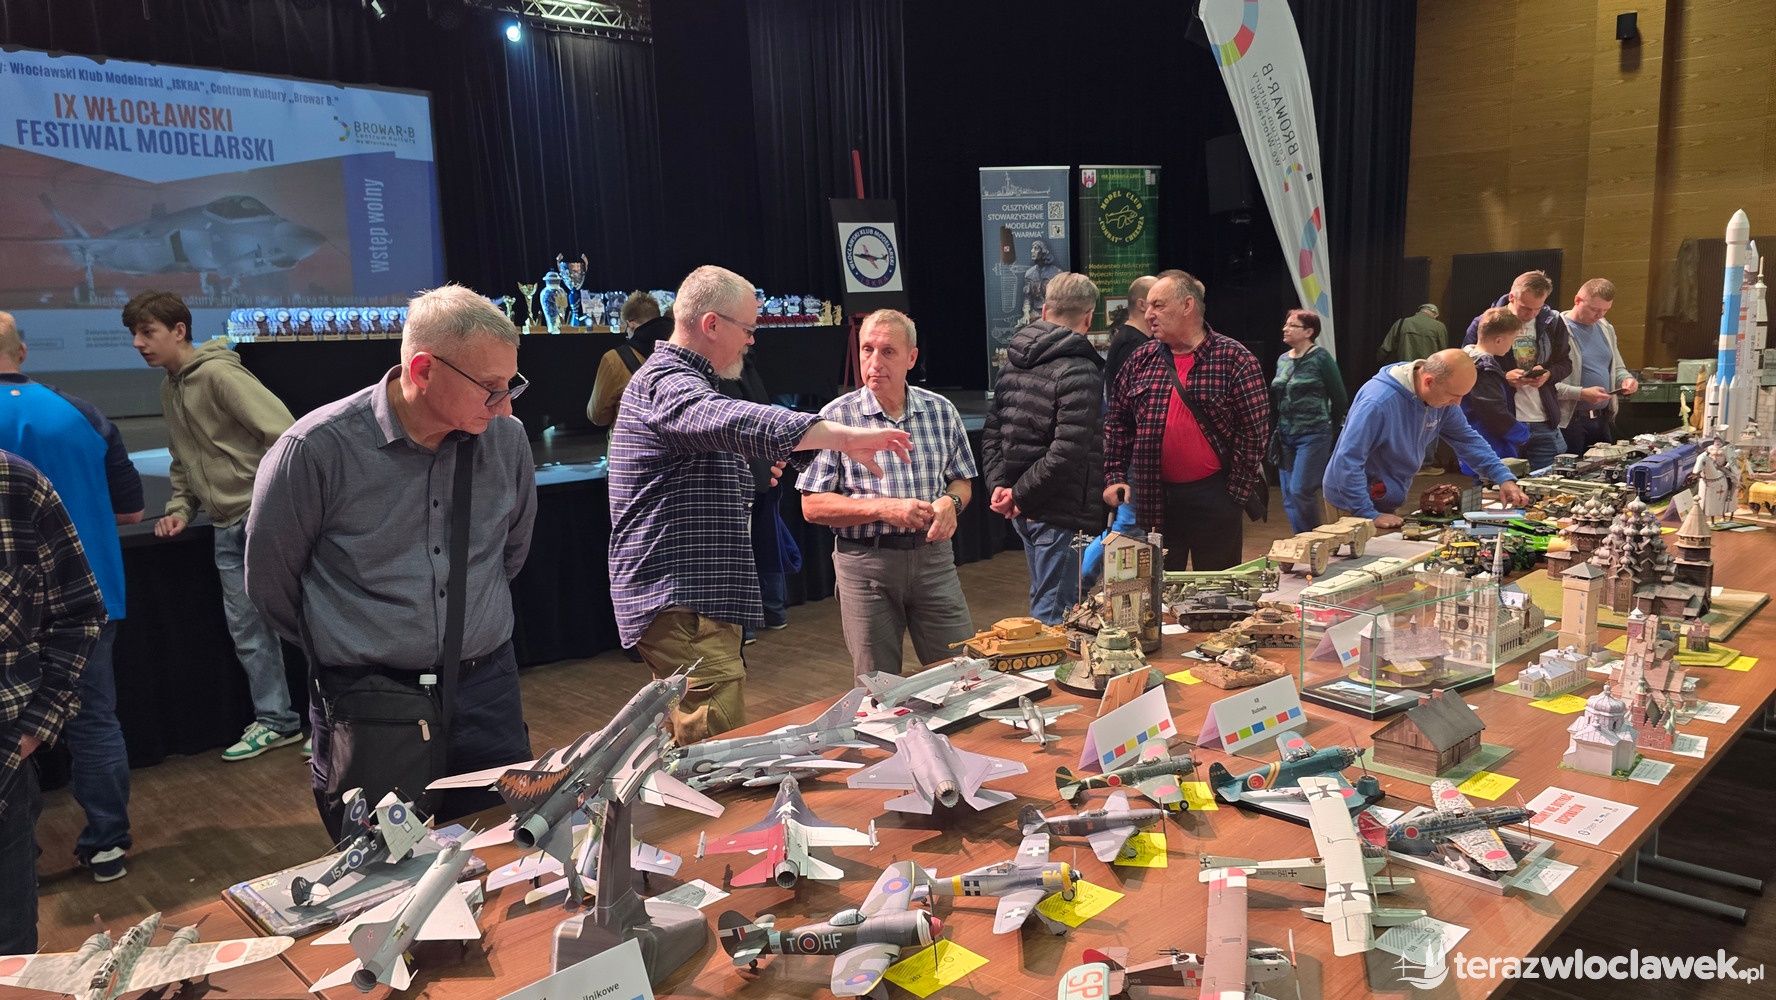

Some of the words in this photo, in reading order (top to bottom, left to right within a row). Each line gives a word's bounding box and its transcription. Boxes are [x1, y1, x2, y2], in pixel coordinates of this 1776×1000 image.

[10, 62, 76, 80] Włocławski
[79, 68, 102, 83] Klub
[105, 72, 163, 88] Modelarski
[211, 83, 250, 98] Centrum
[253, 87, 286, 103] Kultury
[54, 92, 78, 119] IX
[84, 95, 233, 132] WŁOCŁAWSKI
[16, 119, 132, 152] FESTIWAL
[137, 127, 275, 162] MODELARSKI
[363, 178, 385, 224] wolny
[987, 213, 1044, 221] STOWARZYSZENIE
[1001, 202, 1044, 211] OLSZTYŃSKIE
[1100, 190, 1122, 210] MODEL
[1125, 191, 1143, 210] CLUB
[1004, 222, 1045, 230] MODELARZY
[369, 227, 393, 273] Wstęp
[330, 866, 341, 880] 15
[369, 839, 378, 851] 5
[786, 937, 795, 952] T
[822, 932, 842, 950] HF
[1068, 971, 1104, 999] SP
